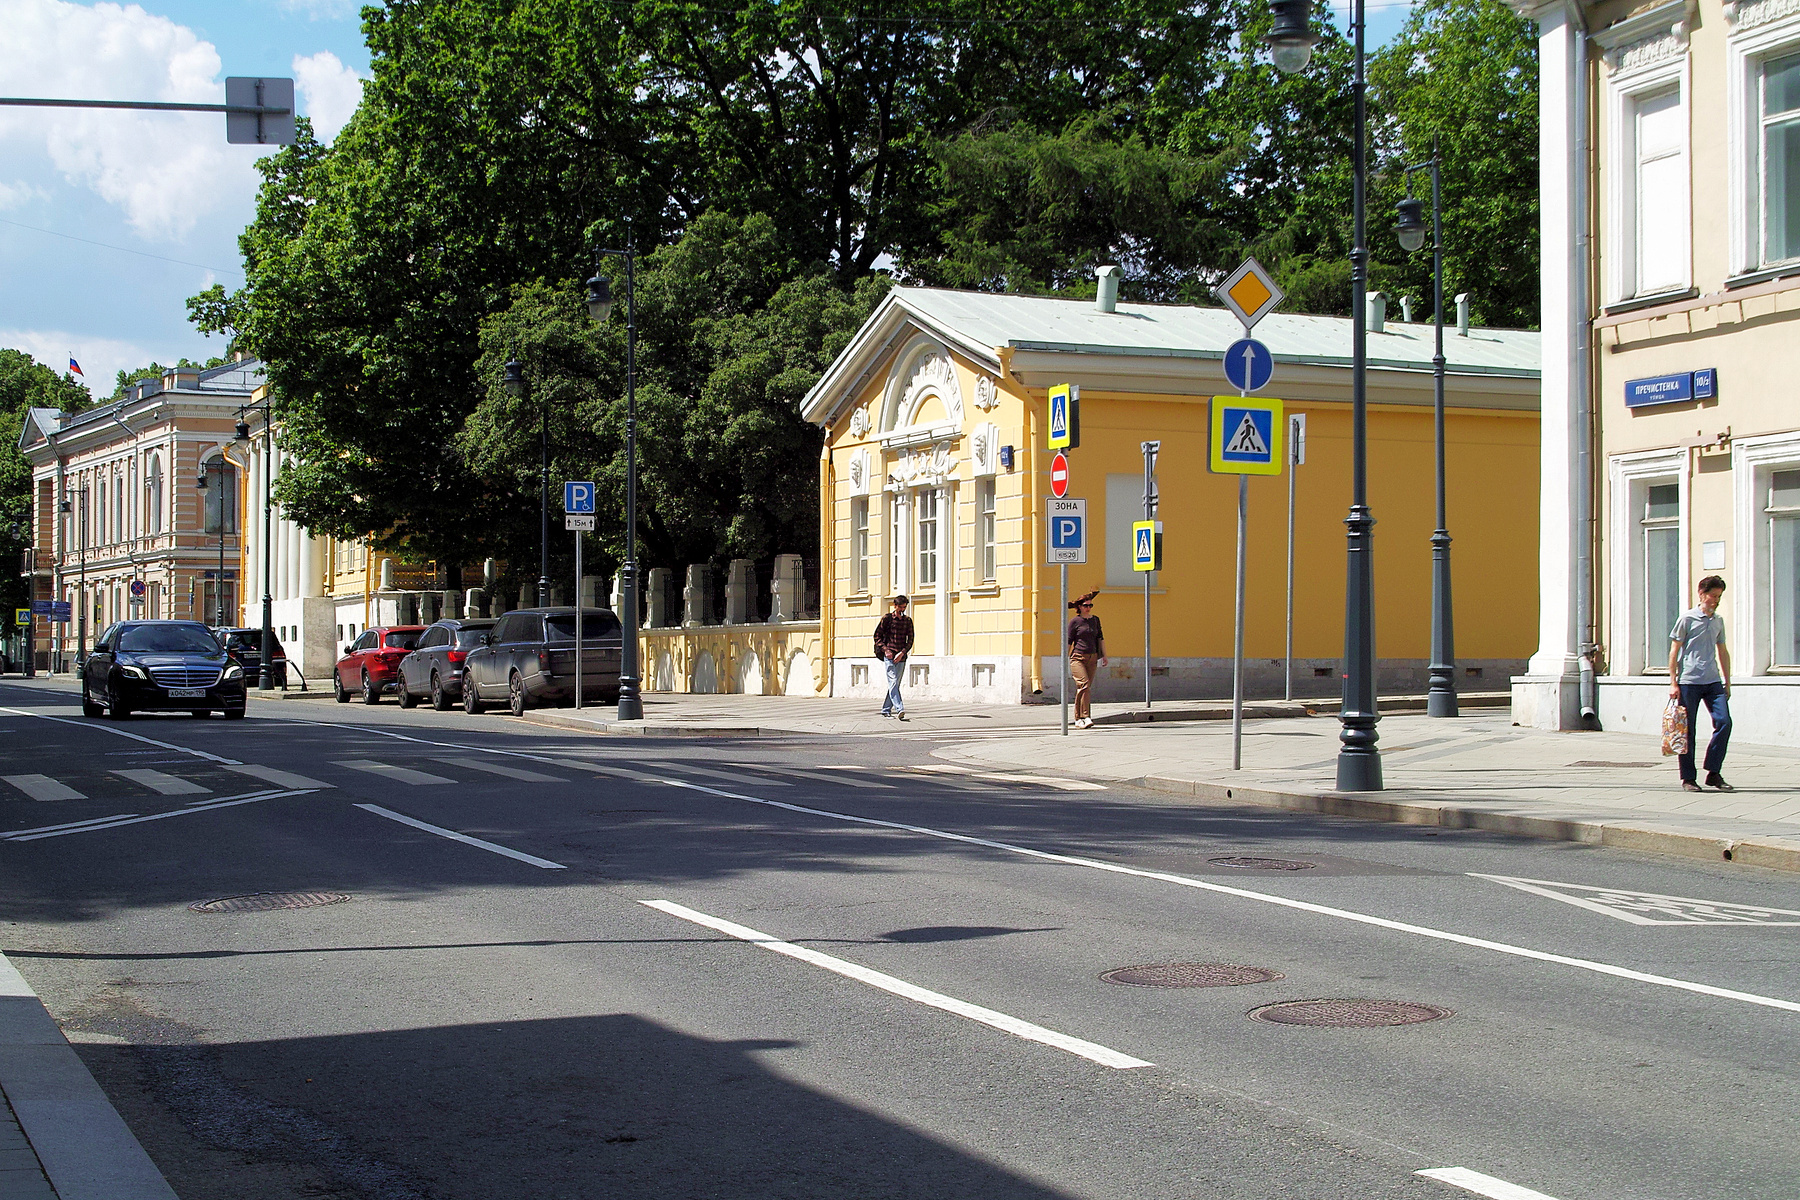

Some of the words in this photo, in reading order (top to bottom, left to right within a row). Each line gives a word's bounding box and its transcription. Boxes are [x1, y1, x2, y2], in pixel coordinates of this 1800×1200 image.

[1635, 381, 1679, 395] ПРЕЧИСТЕНКА
[1696, 376, 1709, 387] 10/2
[572, 485, 589, 509] P
[1055, 502, 1078, 510] ЗОНА
[1060, 520, 1076, 545] P
